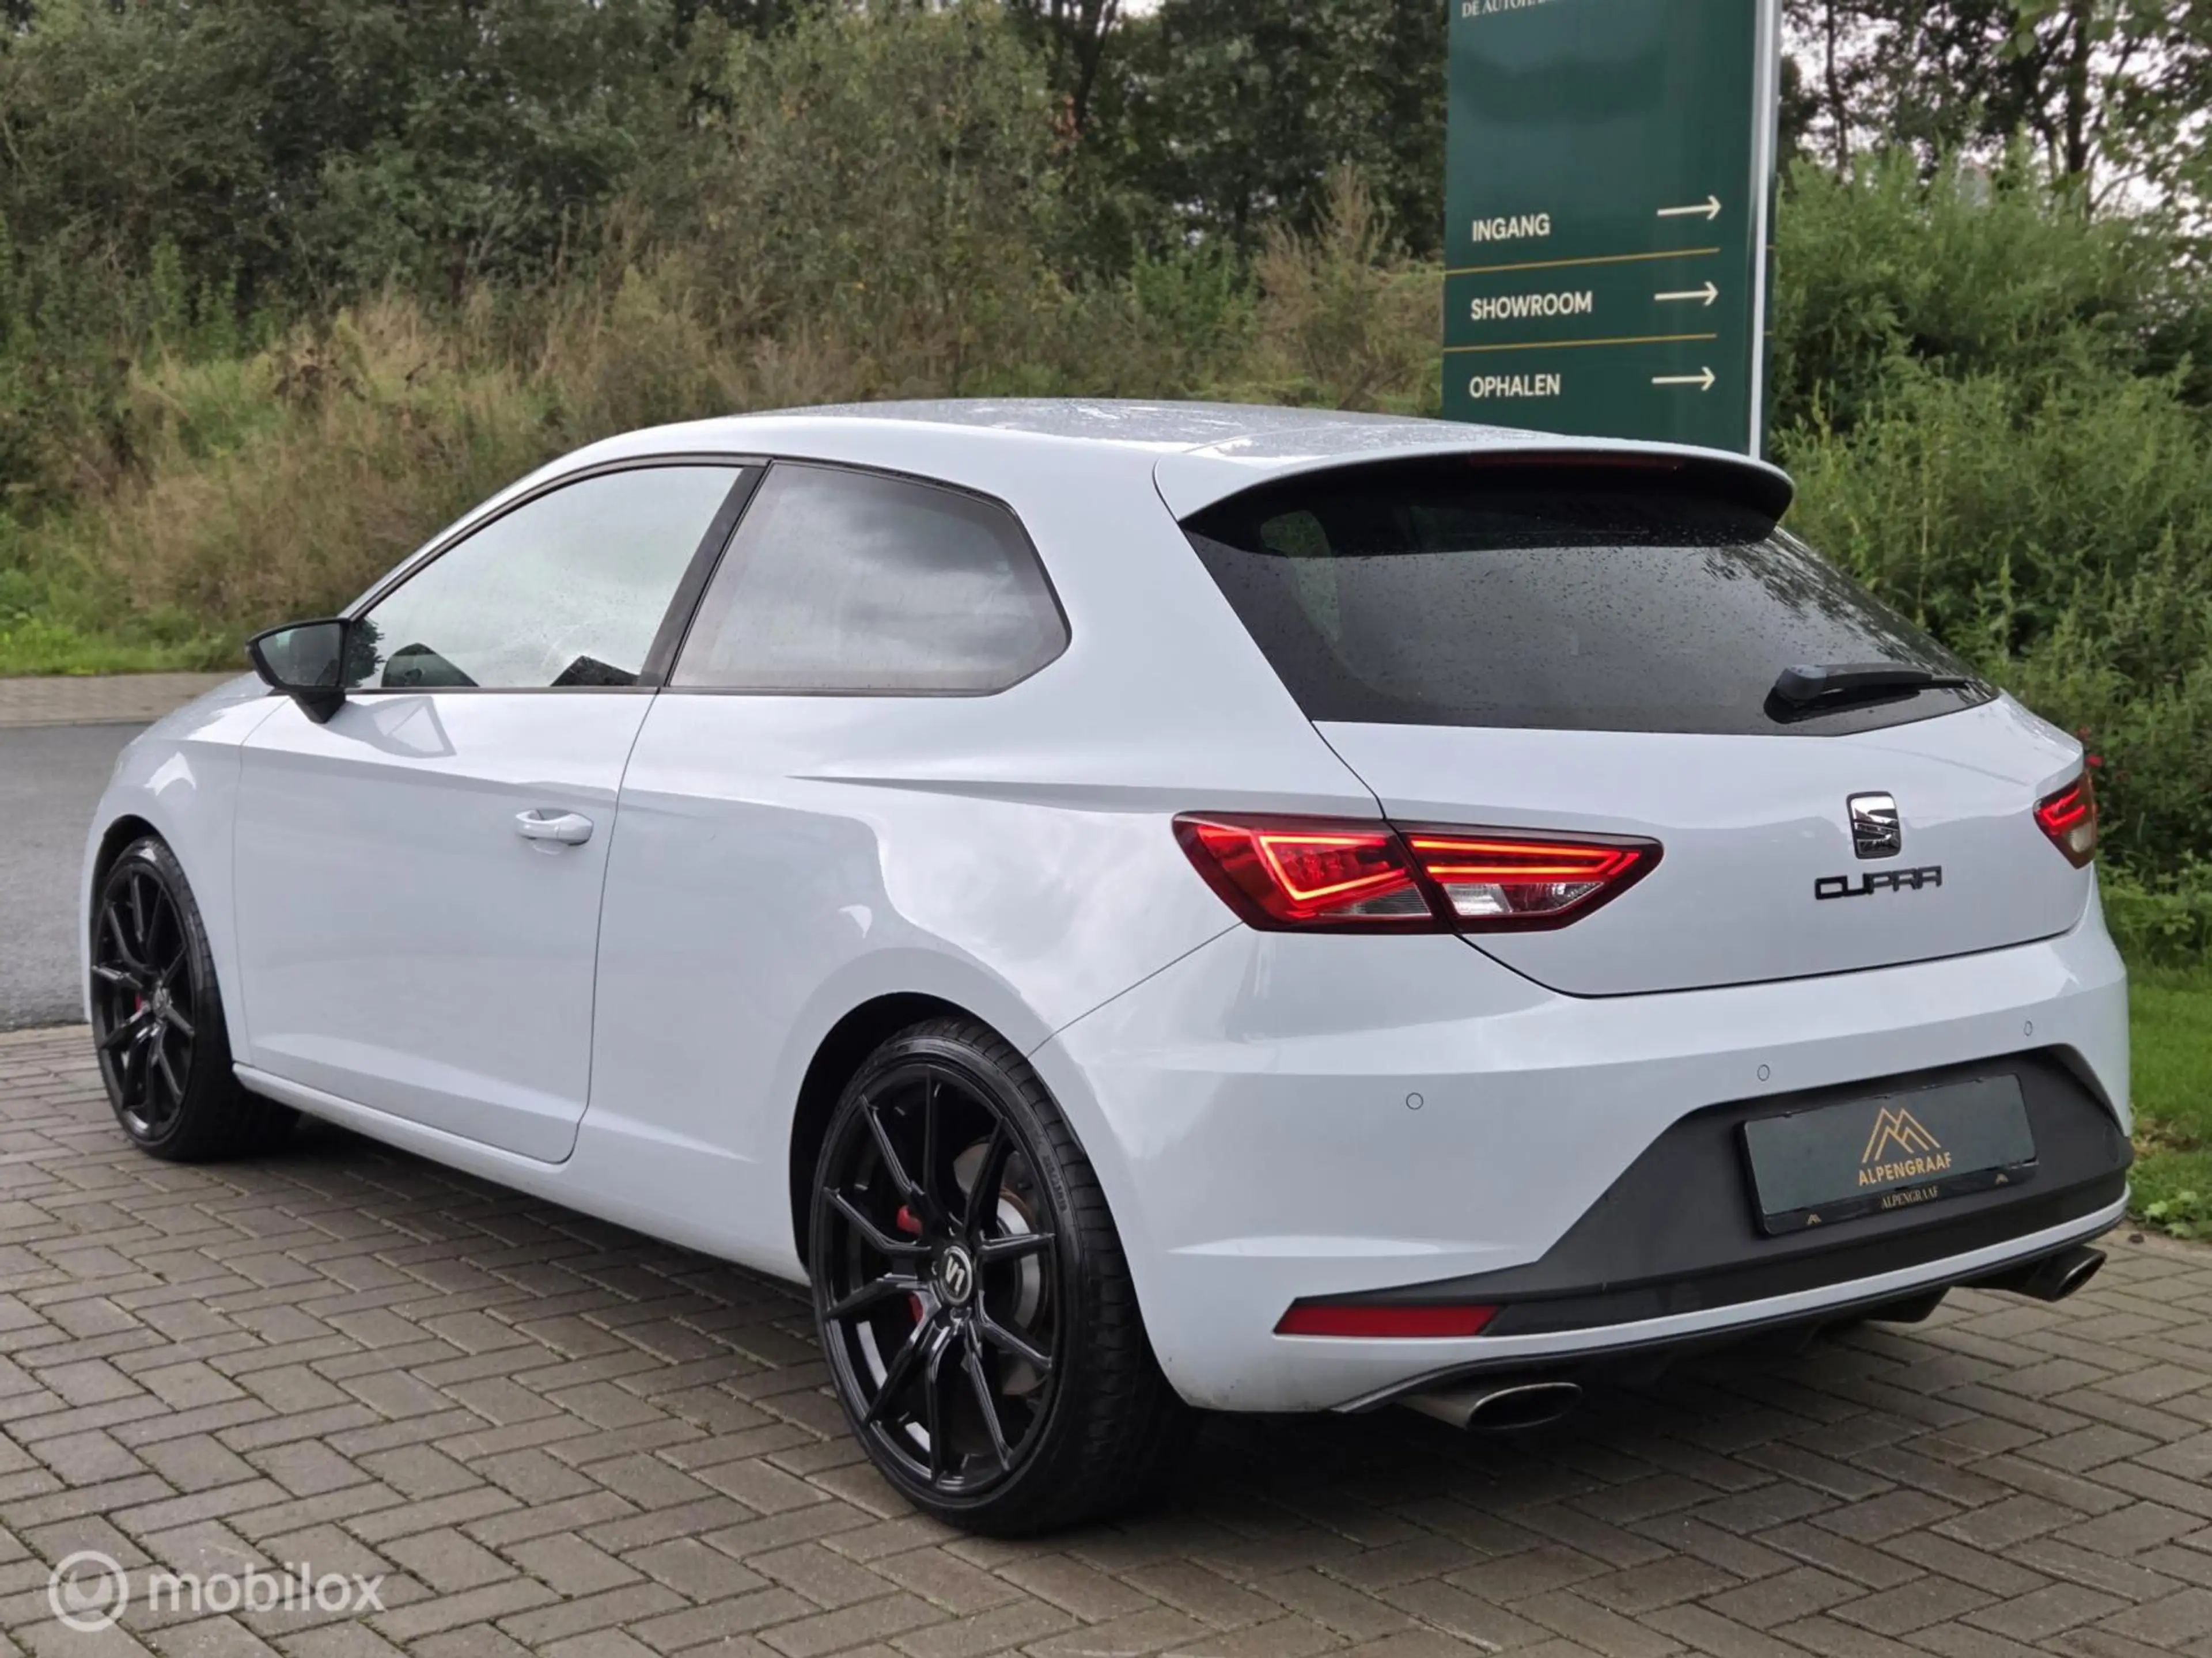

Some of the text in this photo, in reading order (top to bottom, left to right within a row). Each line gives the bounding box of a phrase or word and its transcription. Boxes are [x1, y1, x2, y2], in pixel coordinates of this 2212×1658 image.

[1461, 1, 1479, 18] DE
[1472, 213, 1551, 242] INGANG
[1471, 291, 1593, 320] SHOWROOM
[1469, 374, 1560, 398] OPHALEN
[1815, 865, 1942, 900] CUPRA
[1858, 1151, 1952, 1186] ALPENGRAAF
